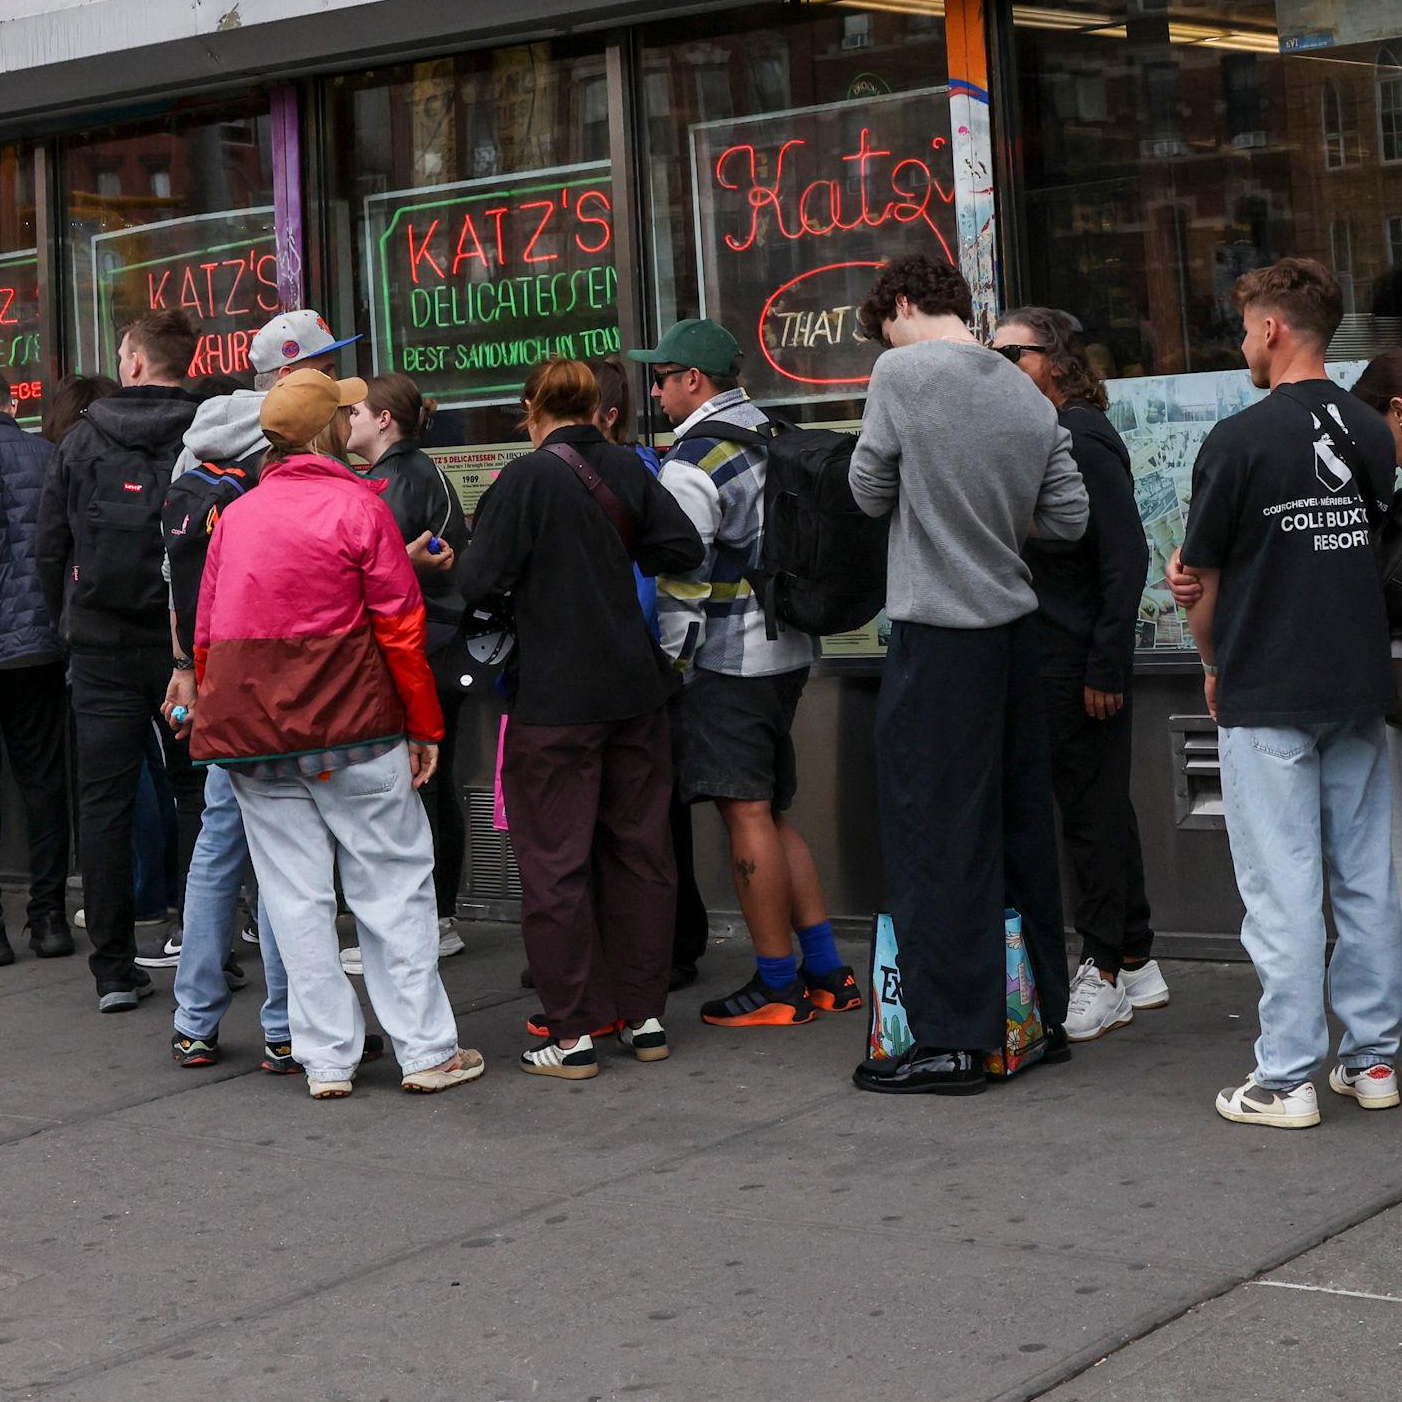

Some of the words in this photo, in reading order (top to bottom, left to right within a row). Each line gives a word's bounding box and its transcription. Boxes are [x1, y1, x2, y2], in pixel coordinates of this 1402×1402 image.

[407, 187, 612, 285] KATZ'S
[148, 249, 279, 319] KATZ'S
[403, 346, 451, 372] BEST
[454, 337, 549, 370] SANDWICH
[449, 453, 496, 464] DELICATESSEN
[497, 453, 505, 461] IN
[1280, 512, 1324, 532] COLE
[1313, 529, 1369, 551] RESORT
